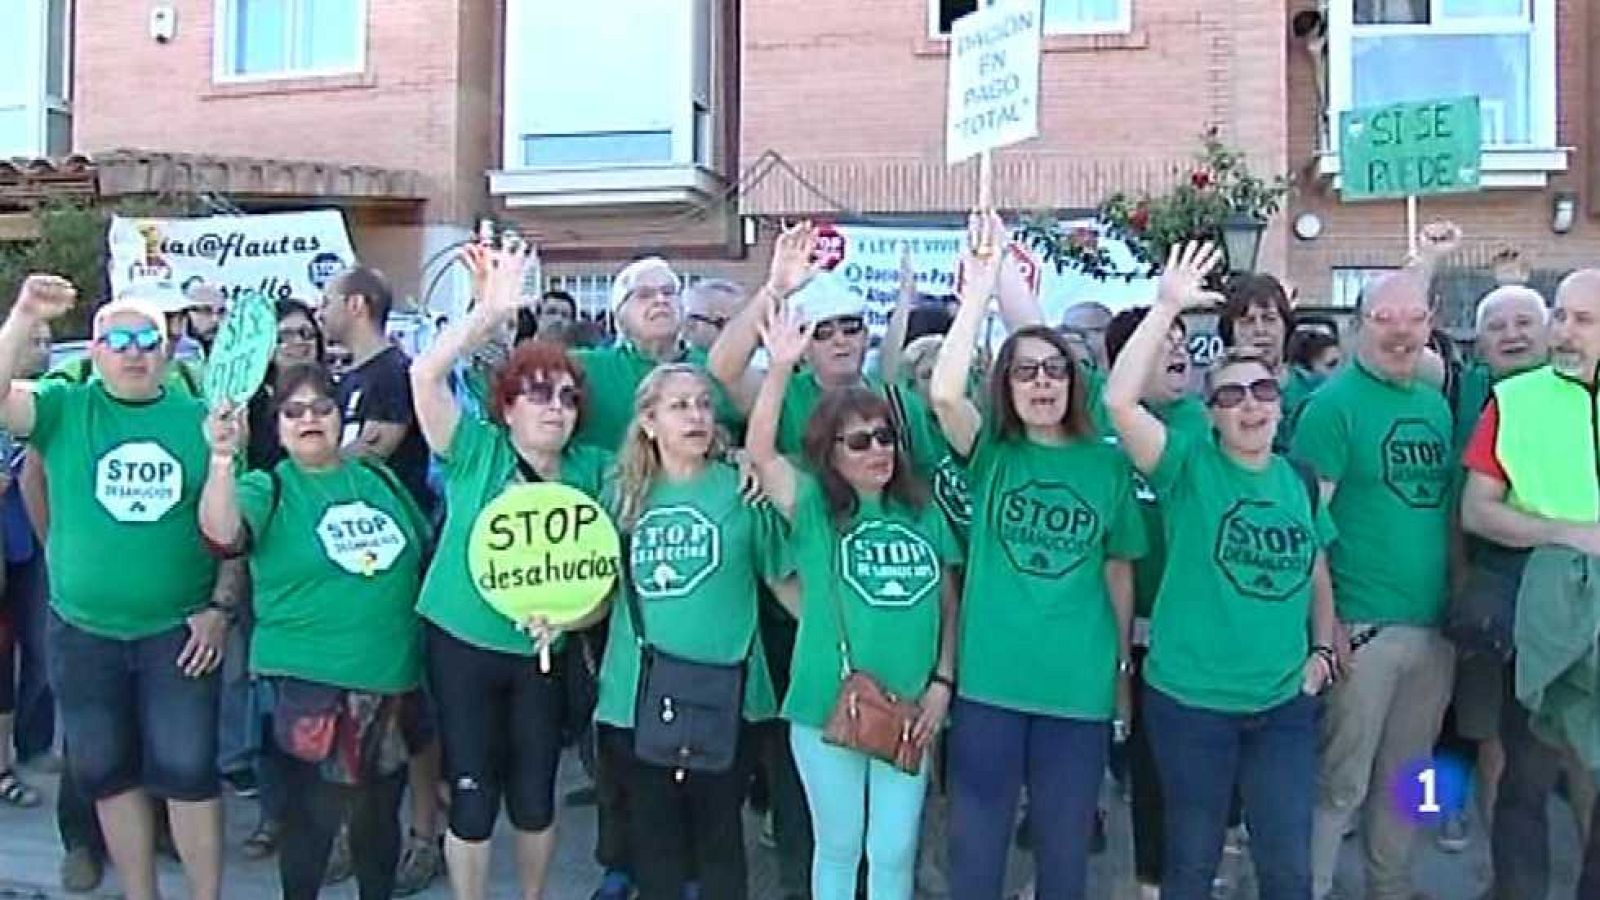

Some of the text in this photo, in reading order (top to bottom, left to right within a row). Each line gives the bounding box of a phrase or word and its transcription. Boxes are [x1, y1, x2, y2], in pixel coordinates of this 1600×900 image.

[979, 49, 1007, 77] EN
[963, 72, 1020, 107] PAGO
[1416, 103, 1454, 141] SE
[1188, 336, 1224, 363] 20
[1390, 440, 1443, 465] STOP
[107, 458, 174, 483] STOP
[327, 514, 387, 539] STOP
[487, 504, 600, 551] STOP
[1005, 496, 1092, 535] STOP
[1228, 518, 1307, 554] STOP
[854, 538, 927, 565] STOP
